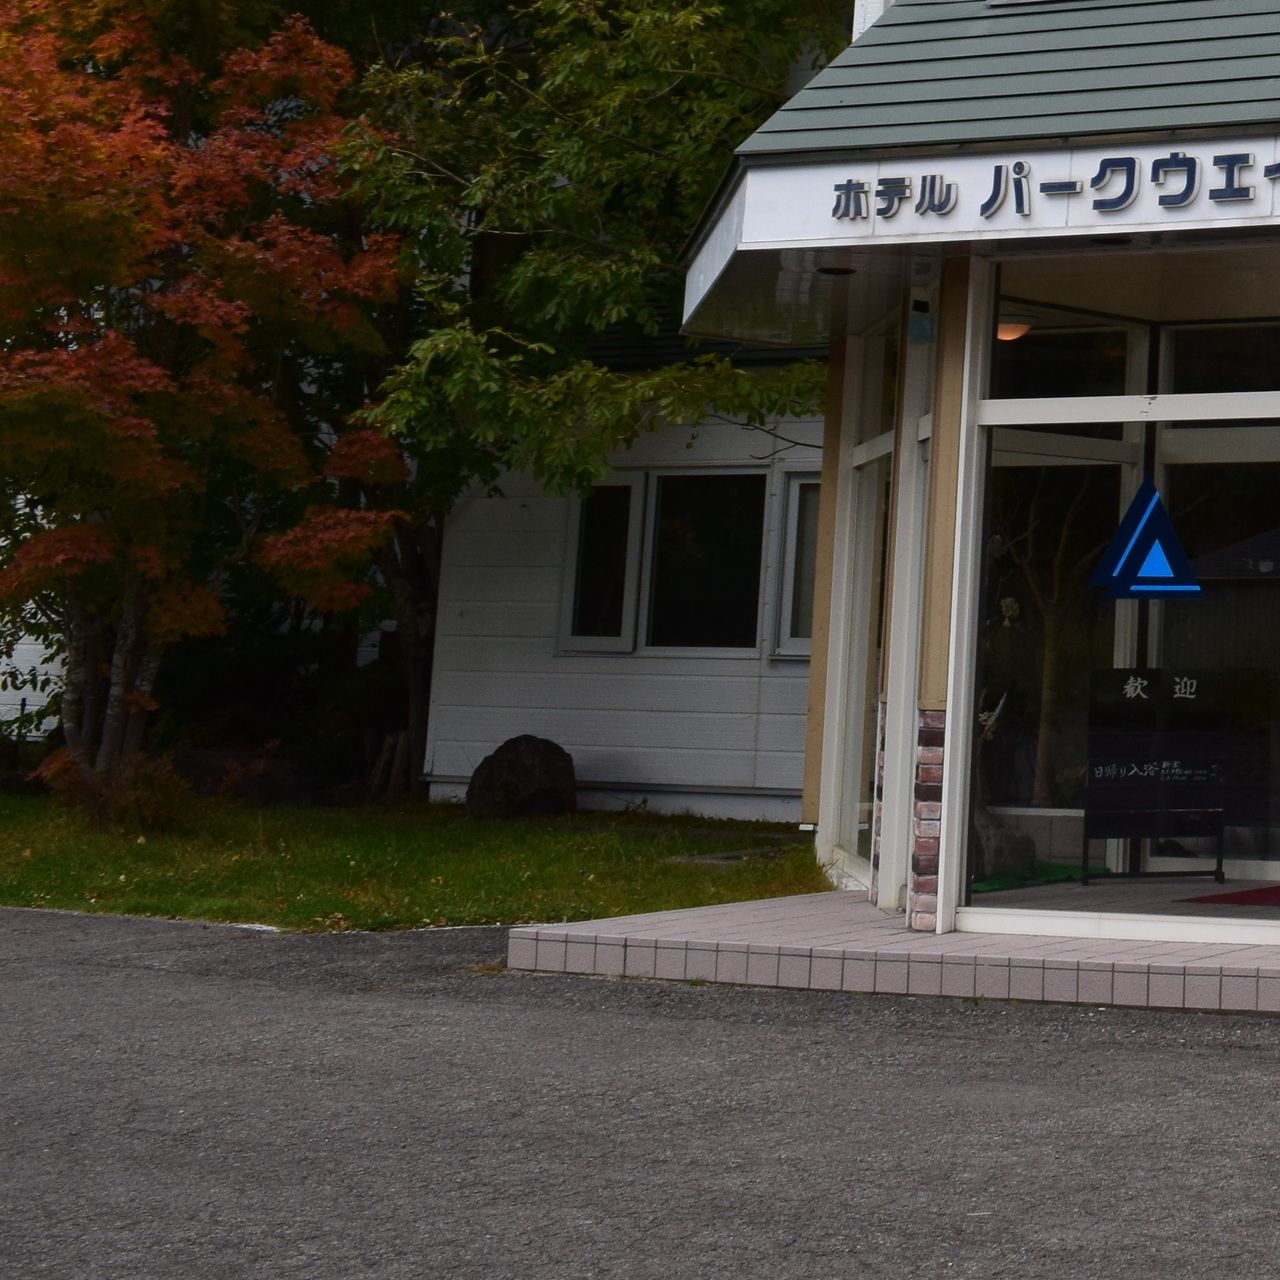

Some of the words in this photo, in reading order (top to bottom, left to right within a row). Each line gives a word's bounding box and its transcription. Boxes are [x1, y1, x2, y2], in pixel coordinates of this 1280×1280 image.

[832, 173, 958, 220] ホテル
[1122, 676, 1197, 699] 歓迎
